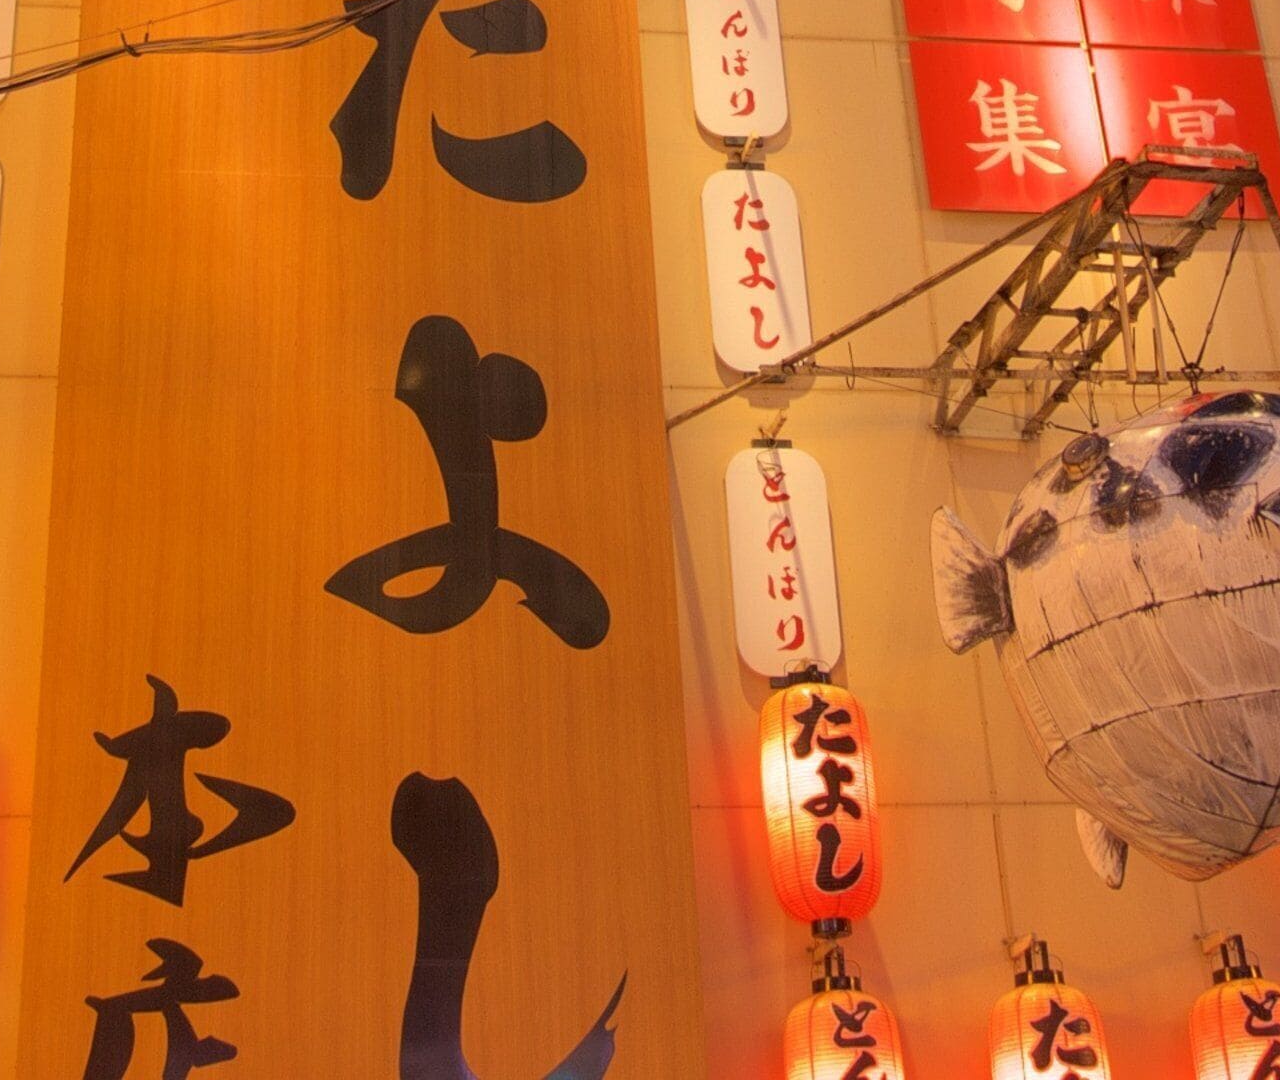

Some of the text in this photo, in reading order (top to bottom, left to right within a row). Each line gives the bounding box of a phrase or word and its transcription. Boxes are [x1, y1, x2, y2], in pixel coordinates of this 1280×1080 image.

[733, 191, 781, 350] たよし
[762, 468, 806, 652] とんぼり
[790, 693, 865, 894] たよし
[1030, 999, 1099, 1080] た
